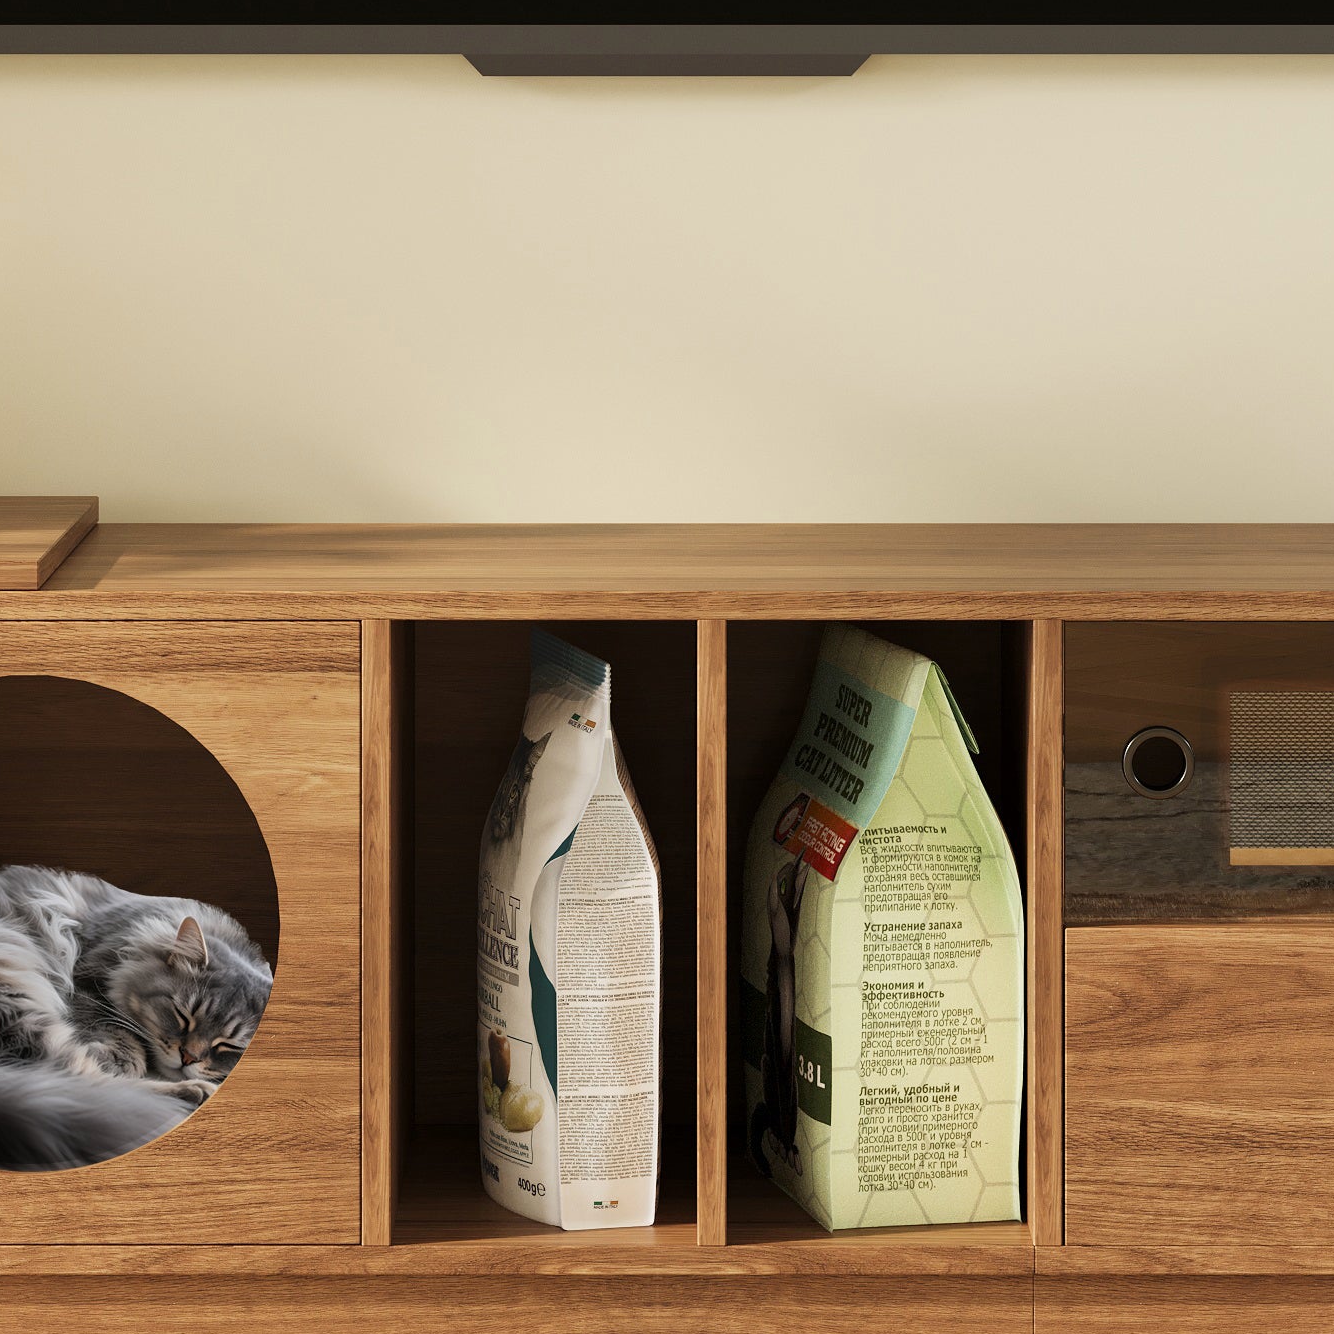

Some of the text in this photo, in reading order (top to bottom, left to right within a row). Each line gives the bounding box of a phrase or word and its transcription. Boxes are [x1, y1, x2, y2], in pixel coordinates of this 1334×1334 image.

[835, 683, 873, 728] SUPER
[813, 712, 874, 770] PREMIUM
[794, 744, 865, 805] CAT LITTER
[805, 816, 823, 835] FAST
[859, 836, 901, 845] чистота
[861, 844, 982, 855] Все жидкости впитываются
[871, 853, 933, 865] формируются
[937, 854, 940, 862] в
[944, 855, 968, 863] комок
[971, 855, 981, 863] на
[863, 863, 922, 876] поверхности
[864, 873, 907, 884] сохраняя
[910, 872, 929, 881] весь
[864, 882, 951, 892] наполнитель сухим
[864, 892, 948, 902] предотвращая его
[864, 903, 920, 913] прилипание
[931, 902, 958, 912] лотку.
[864, 921, 962, 933] Устранение запаха
[862, 981, 914, 991] Экономия
[862, 991, 945, 1002] эффективность
[798, 1054, 826, 1089] 3.8 L
[859, 1085, 900, 1096] Легкий,
[904, 1083, 950, 1096] удобный
[859, 1094, 957, 1105] выгодный по цене
